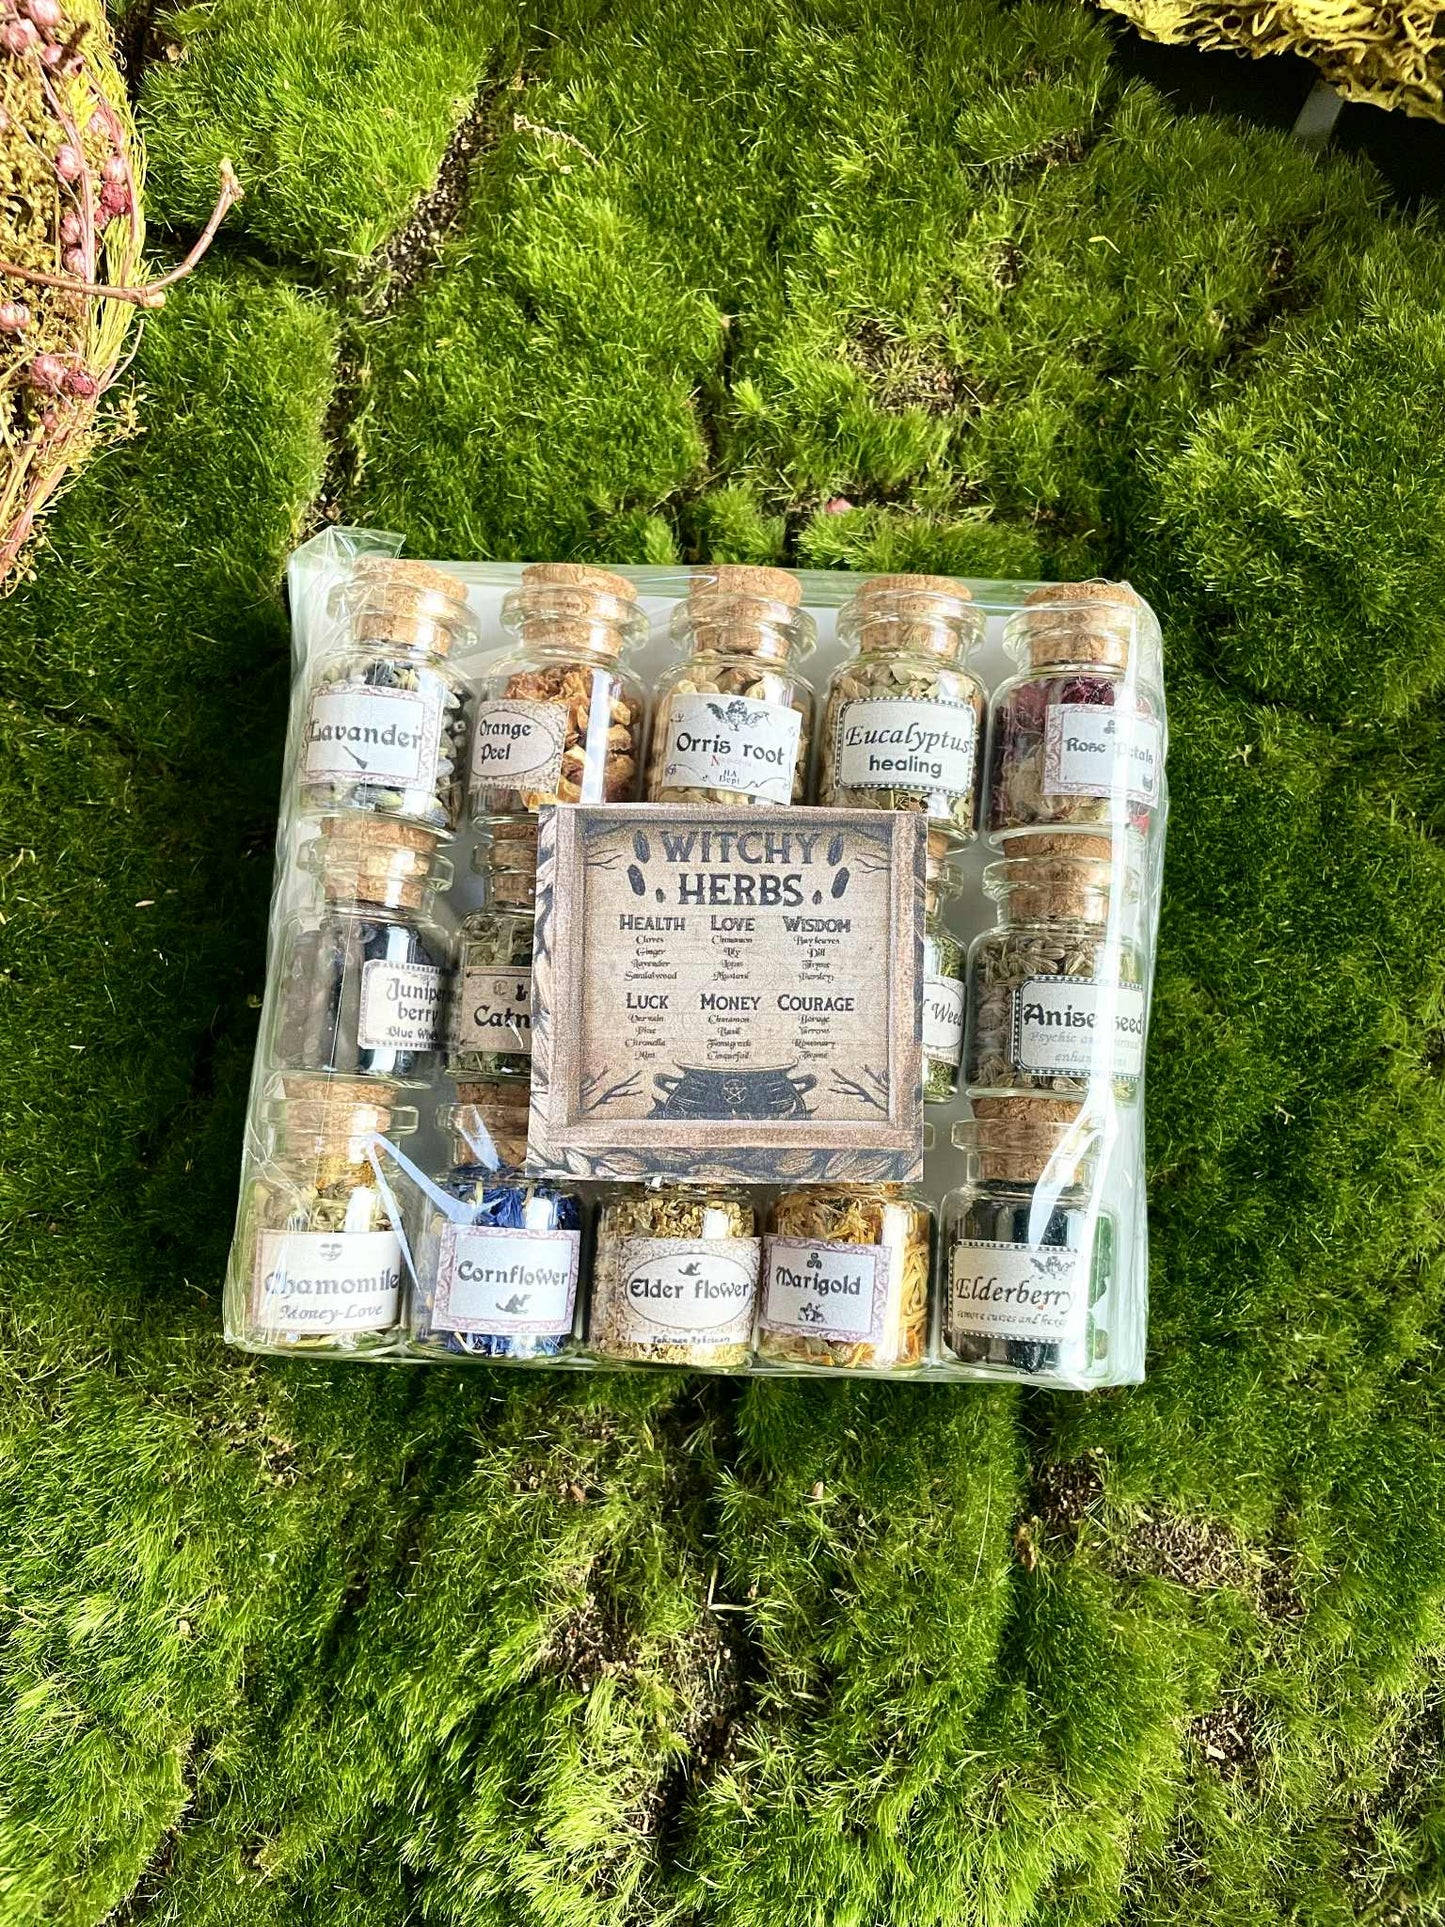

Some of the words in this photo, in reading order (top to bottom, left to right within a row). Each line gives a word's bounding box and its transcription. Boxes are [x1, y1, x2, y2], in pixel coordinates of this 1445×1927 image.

[306, 717, 422, 749] Lavander
[480, 719, 531, 740] Orange
[845, 722, 969, 754] Eucalyptus
[481, 743, 511, 764] Peel
[676, 732, 731, 754] Orris
[743, 744, 785, 766] root
[1063, 737, 1107, 753] Rose
[869, 754, 942, 779] healing
[660, 830, 823, 865] WITCHY
[678, 872, 803, 908] HERBS
[619, 914, 686, 931] HEALTH
[710, 914, 756, 932] LOVE
[782, 915, 851, 933] WISDOM
[635, 934, 664, 945] Cloves
[635, 947, 666, 958] Ginger
[806, 947, 826, 958] Dill
[626, 992, 669, 1009] LUCK
[700, 993, 761, 1010] MONEY
[777, 994, 855, 1011] COURAGE
[398, 1001, 439, 1027] berry
[1023, 1003, 1097, 1028] Anise
[264, 1267, 400, 1299] Chamomile
[457, 1260, 568, 1287] Cornflower
[776, 1265, 861, 1296] Marigold
[630, 1278, 684, 1299] Elder
[694, 1279, 749, 1299] flower
[955, 1276, 1073, 1315] Elderberry
[280, 1303, 383, 1325] Money-Love
